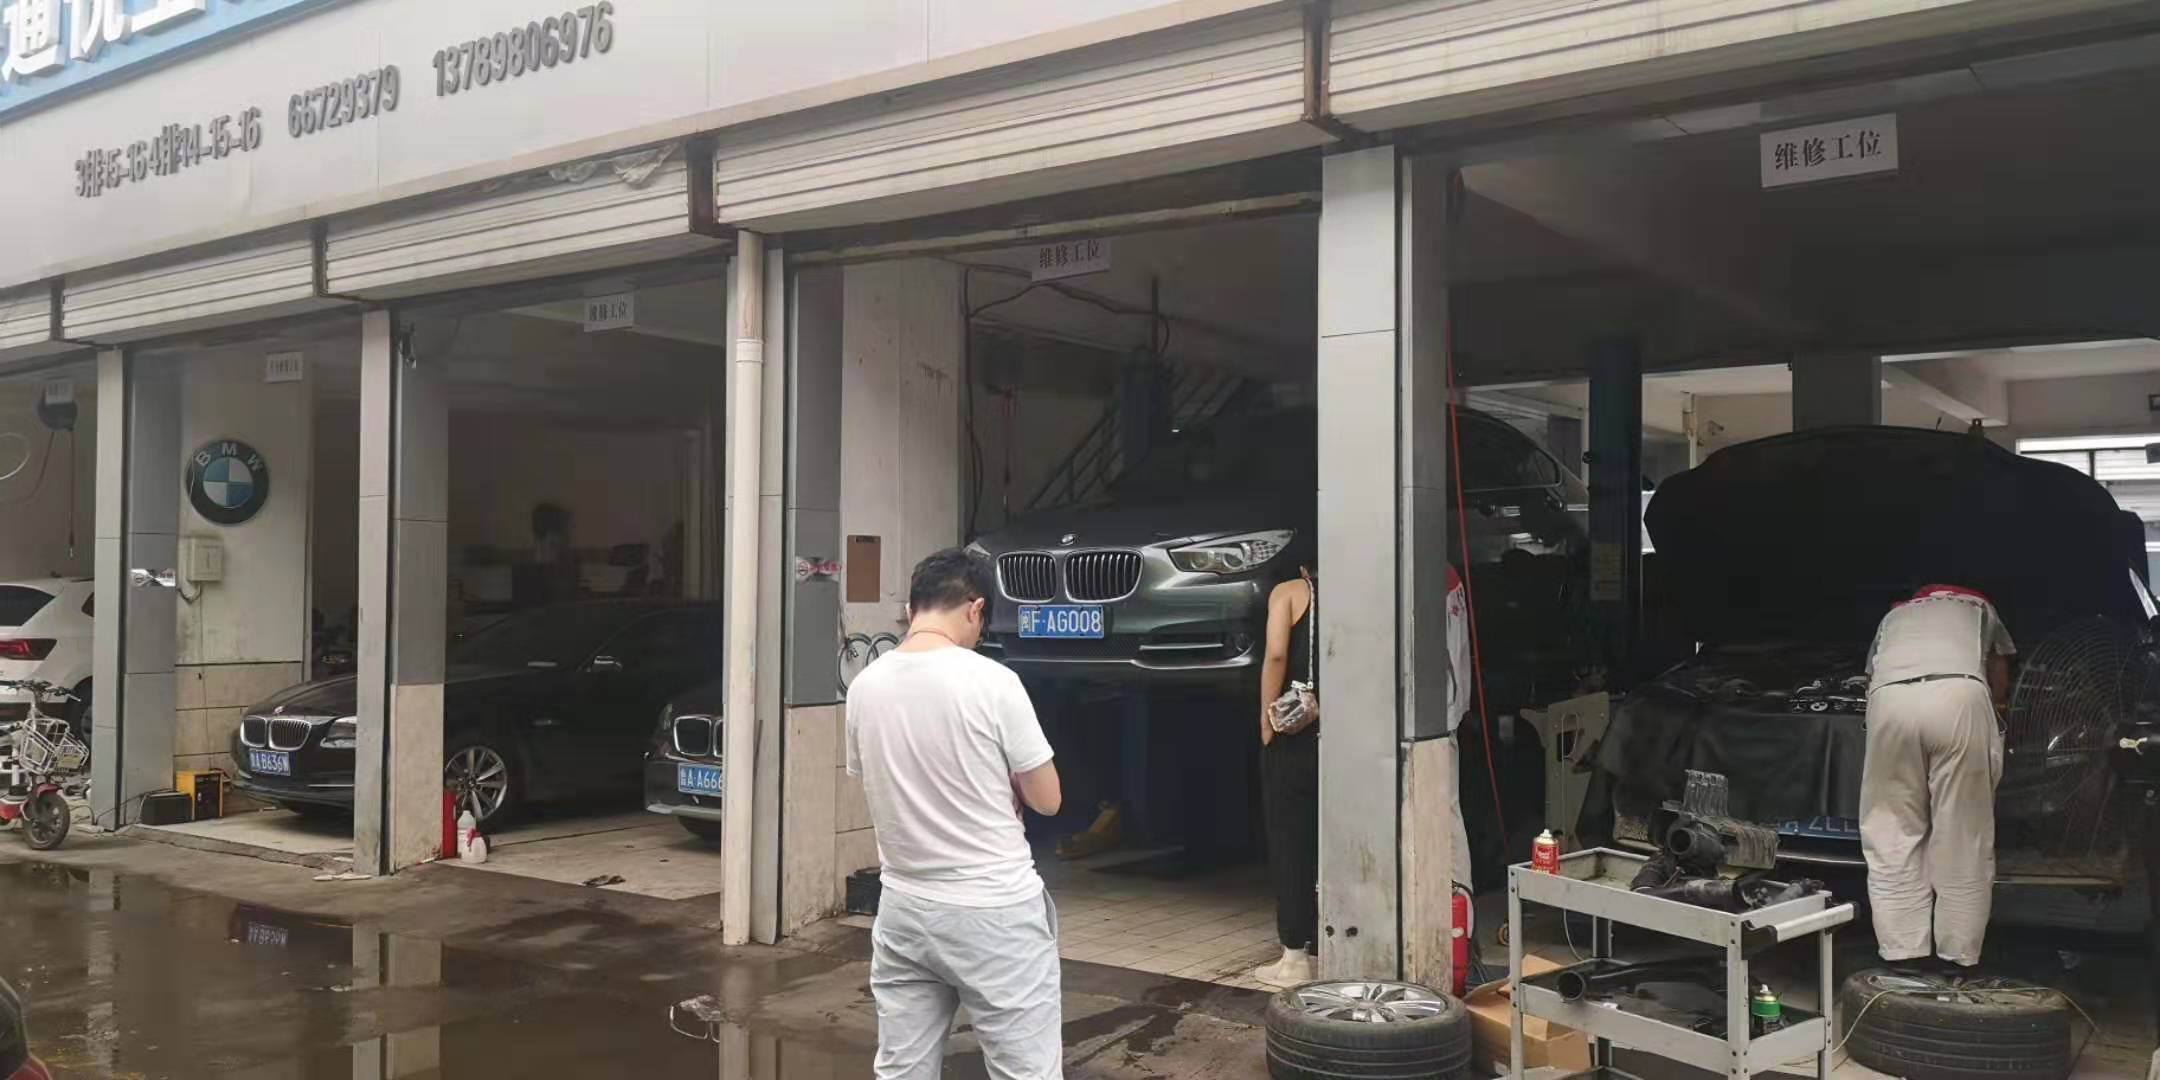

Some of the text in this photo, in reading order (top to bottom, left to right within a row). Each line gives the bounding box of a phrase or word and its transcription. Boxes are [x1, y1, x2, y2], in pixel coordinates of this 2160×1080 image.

[288, 65, 400, 138] 66729379
[432, 2, 614, 96] 13789806976
[1774, 130, 1882, 170] 维修工位
[1039, 239, 1101, 269] 维修工位
[197, 443, 263, 472] BMW
